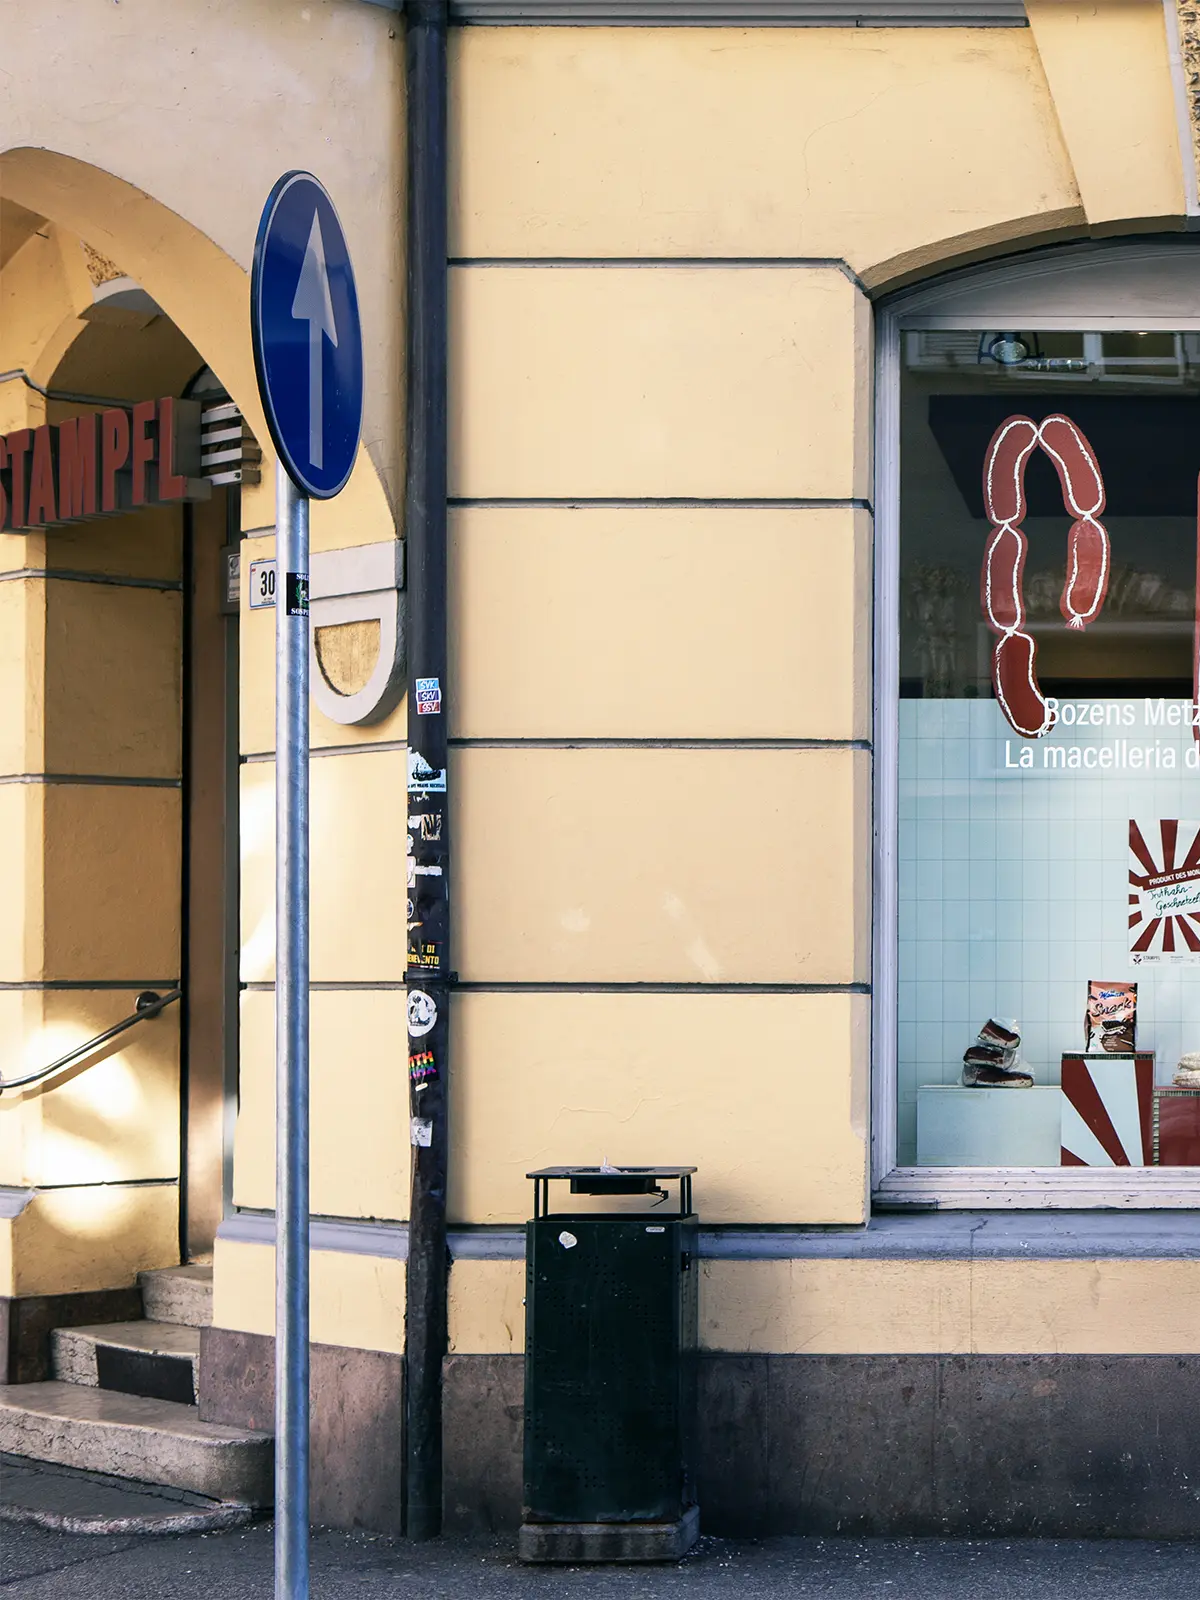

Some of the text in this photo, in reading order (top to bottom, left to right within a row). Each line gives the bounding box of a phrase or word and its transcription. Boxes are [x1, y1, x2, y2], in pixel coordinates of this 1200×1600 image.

[260, 570, 275, 597] 30
[421, 690, 436, 701] SKV
[1044, 697, 1136, 726] Bozens
[1005, 740, 1034, 769] La
[1043, 739, 1176, 769] macelleria
[1149, 874, 1175, 886] PRODUKT
[1175, 871, 1187, 880] DES
[1092, 997, 1132, 1017] Snack
